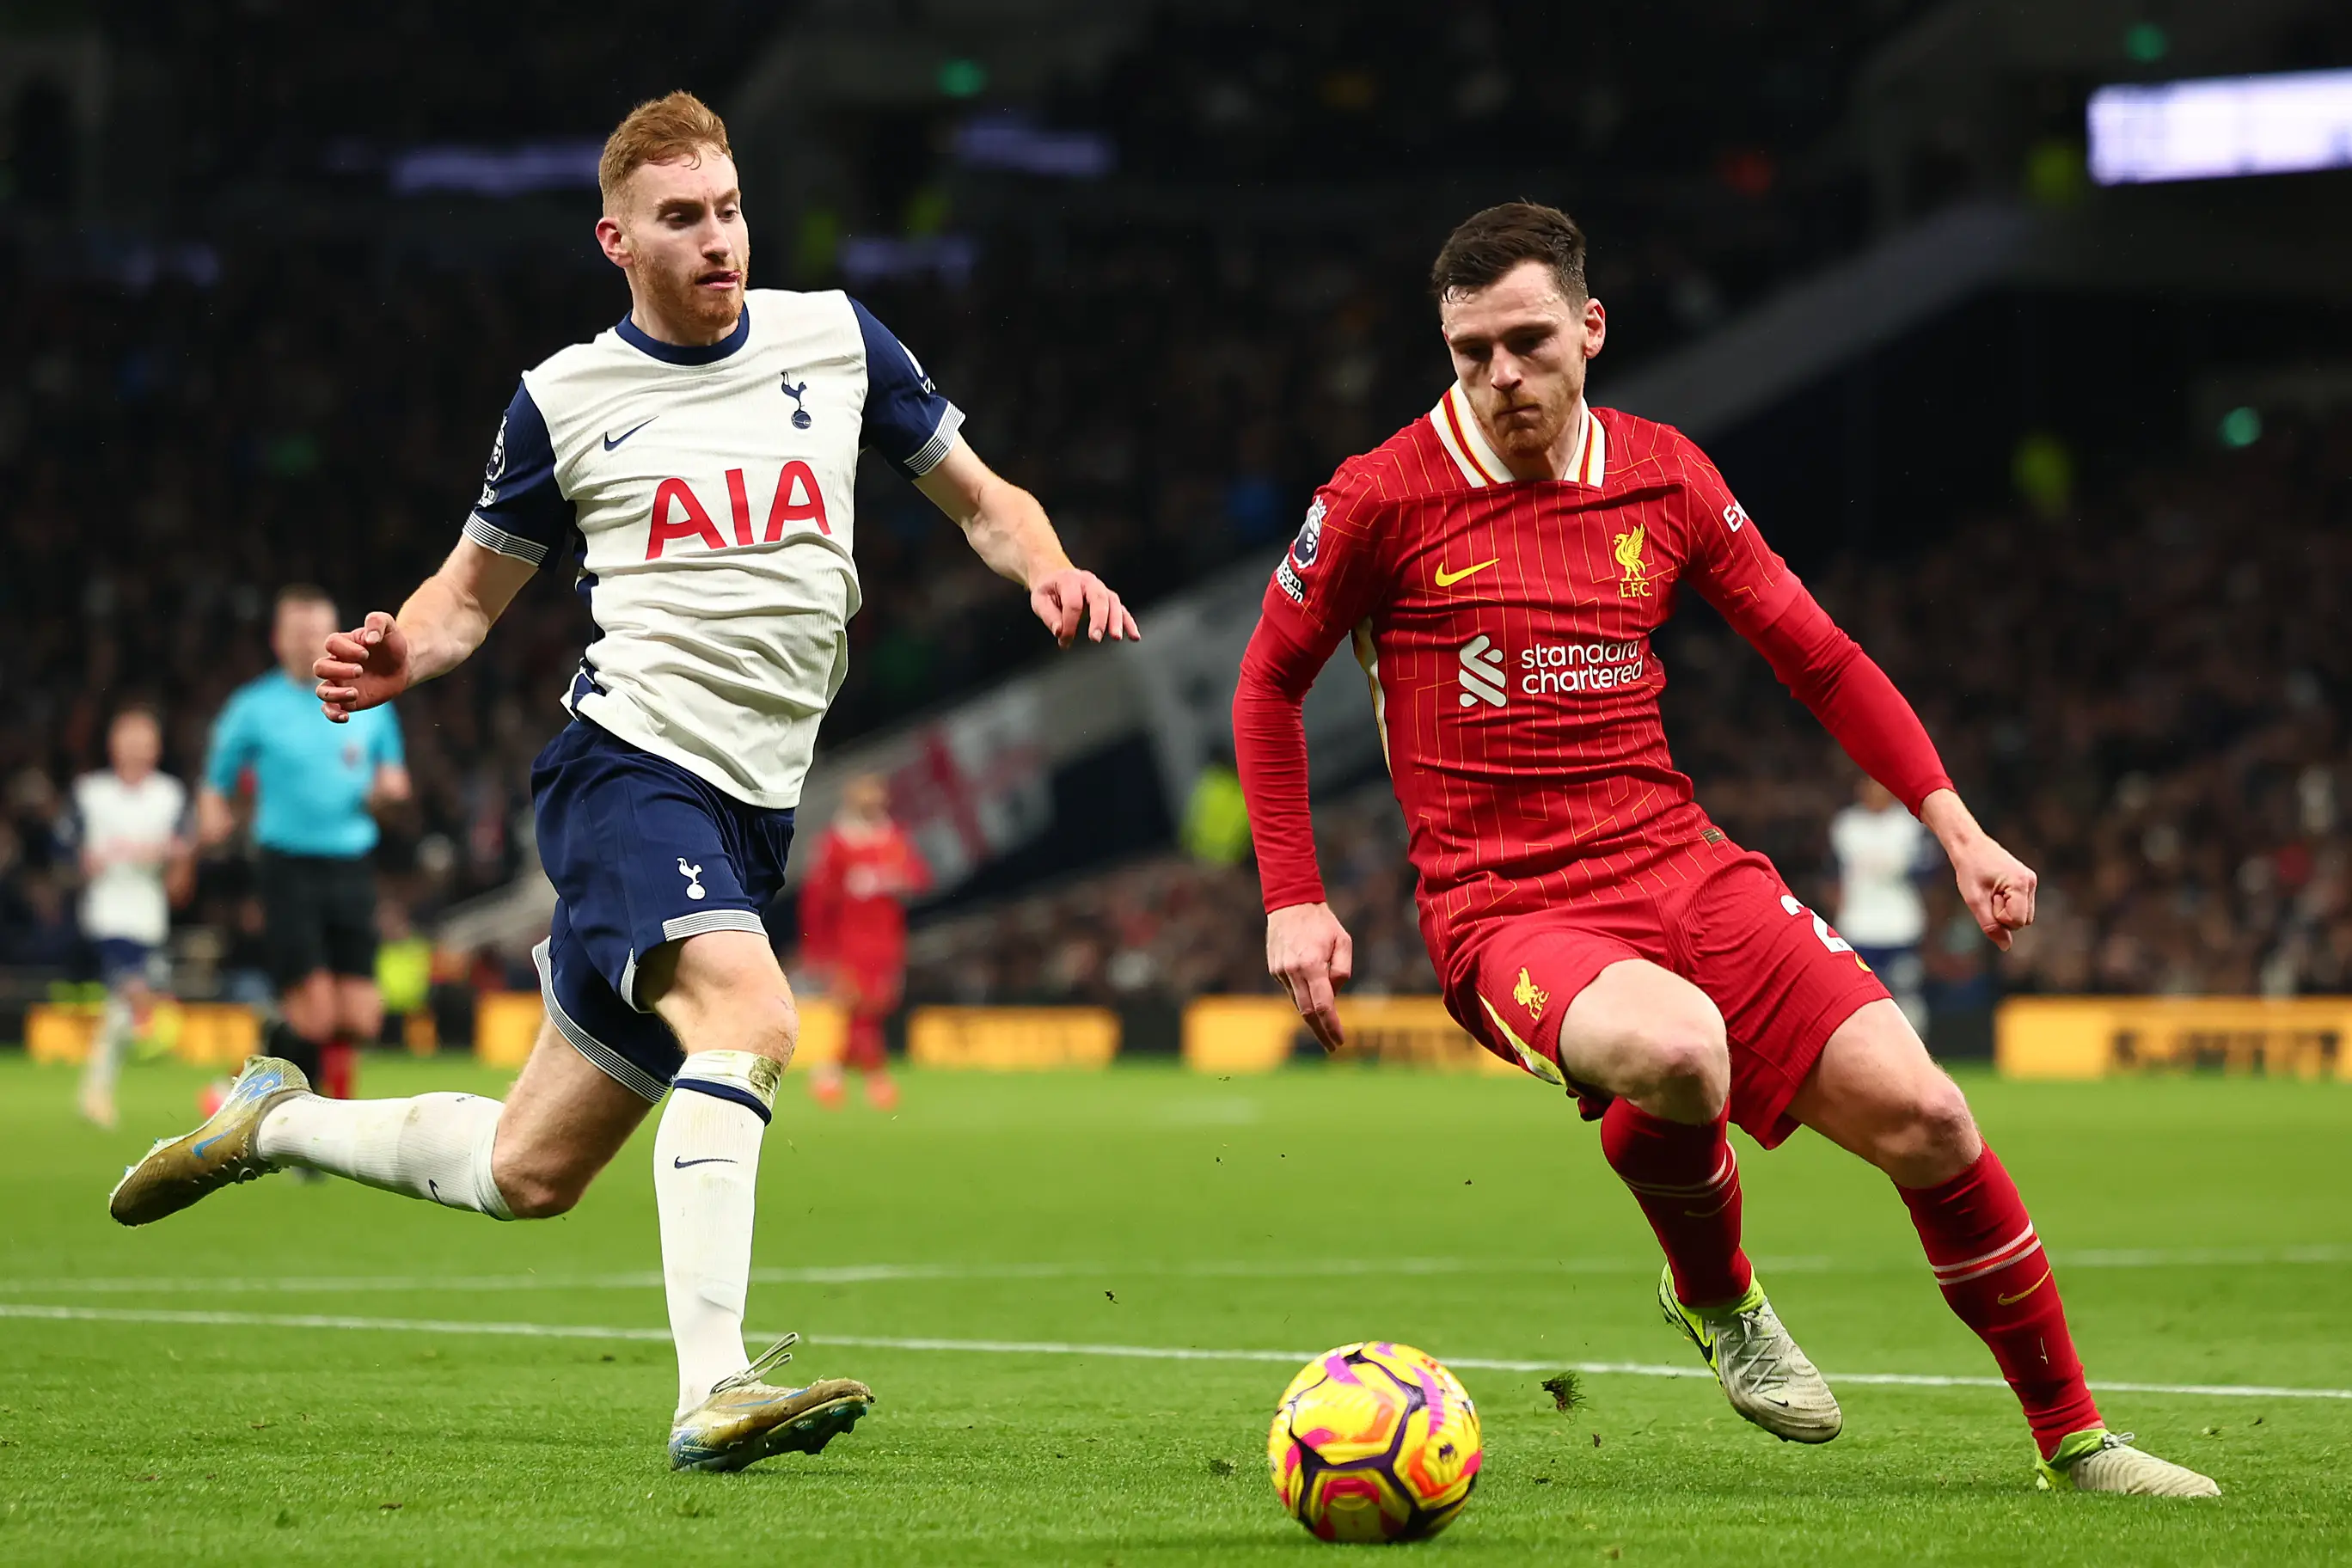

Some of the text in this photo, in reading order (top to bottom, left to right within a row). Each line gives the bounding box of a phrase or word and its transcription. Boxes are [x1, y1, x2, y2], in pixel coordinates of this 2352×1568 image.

[646, 460, 832, 560] AIA
[1521, 640, 1639, 669] standard
[1522, 656, 1644, 694] chartered
